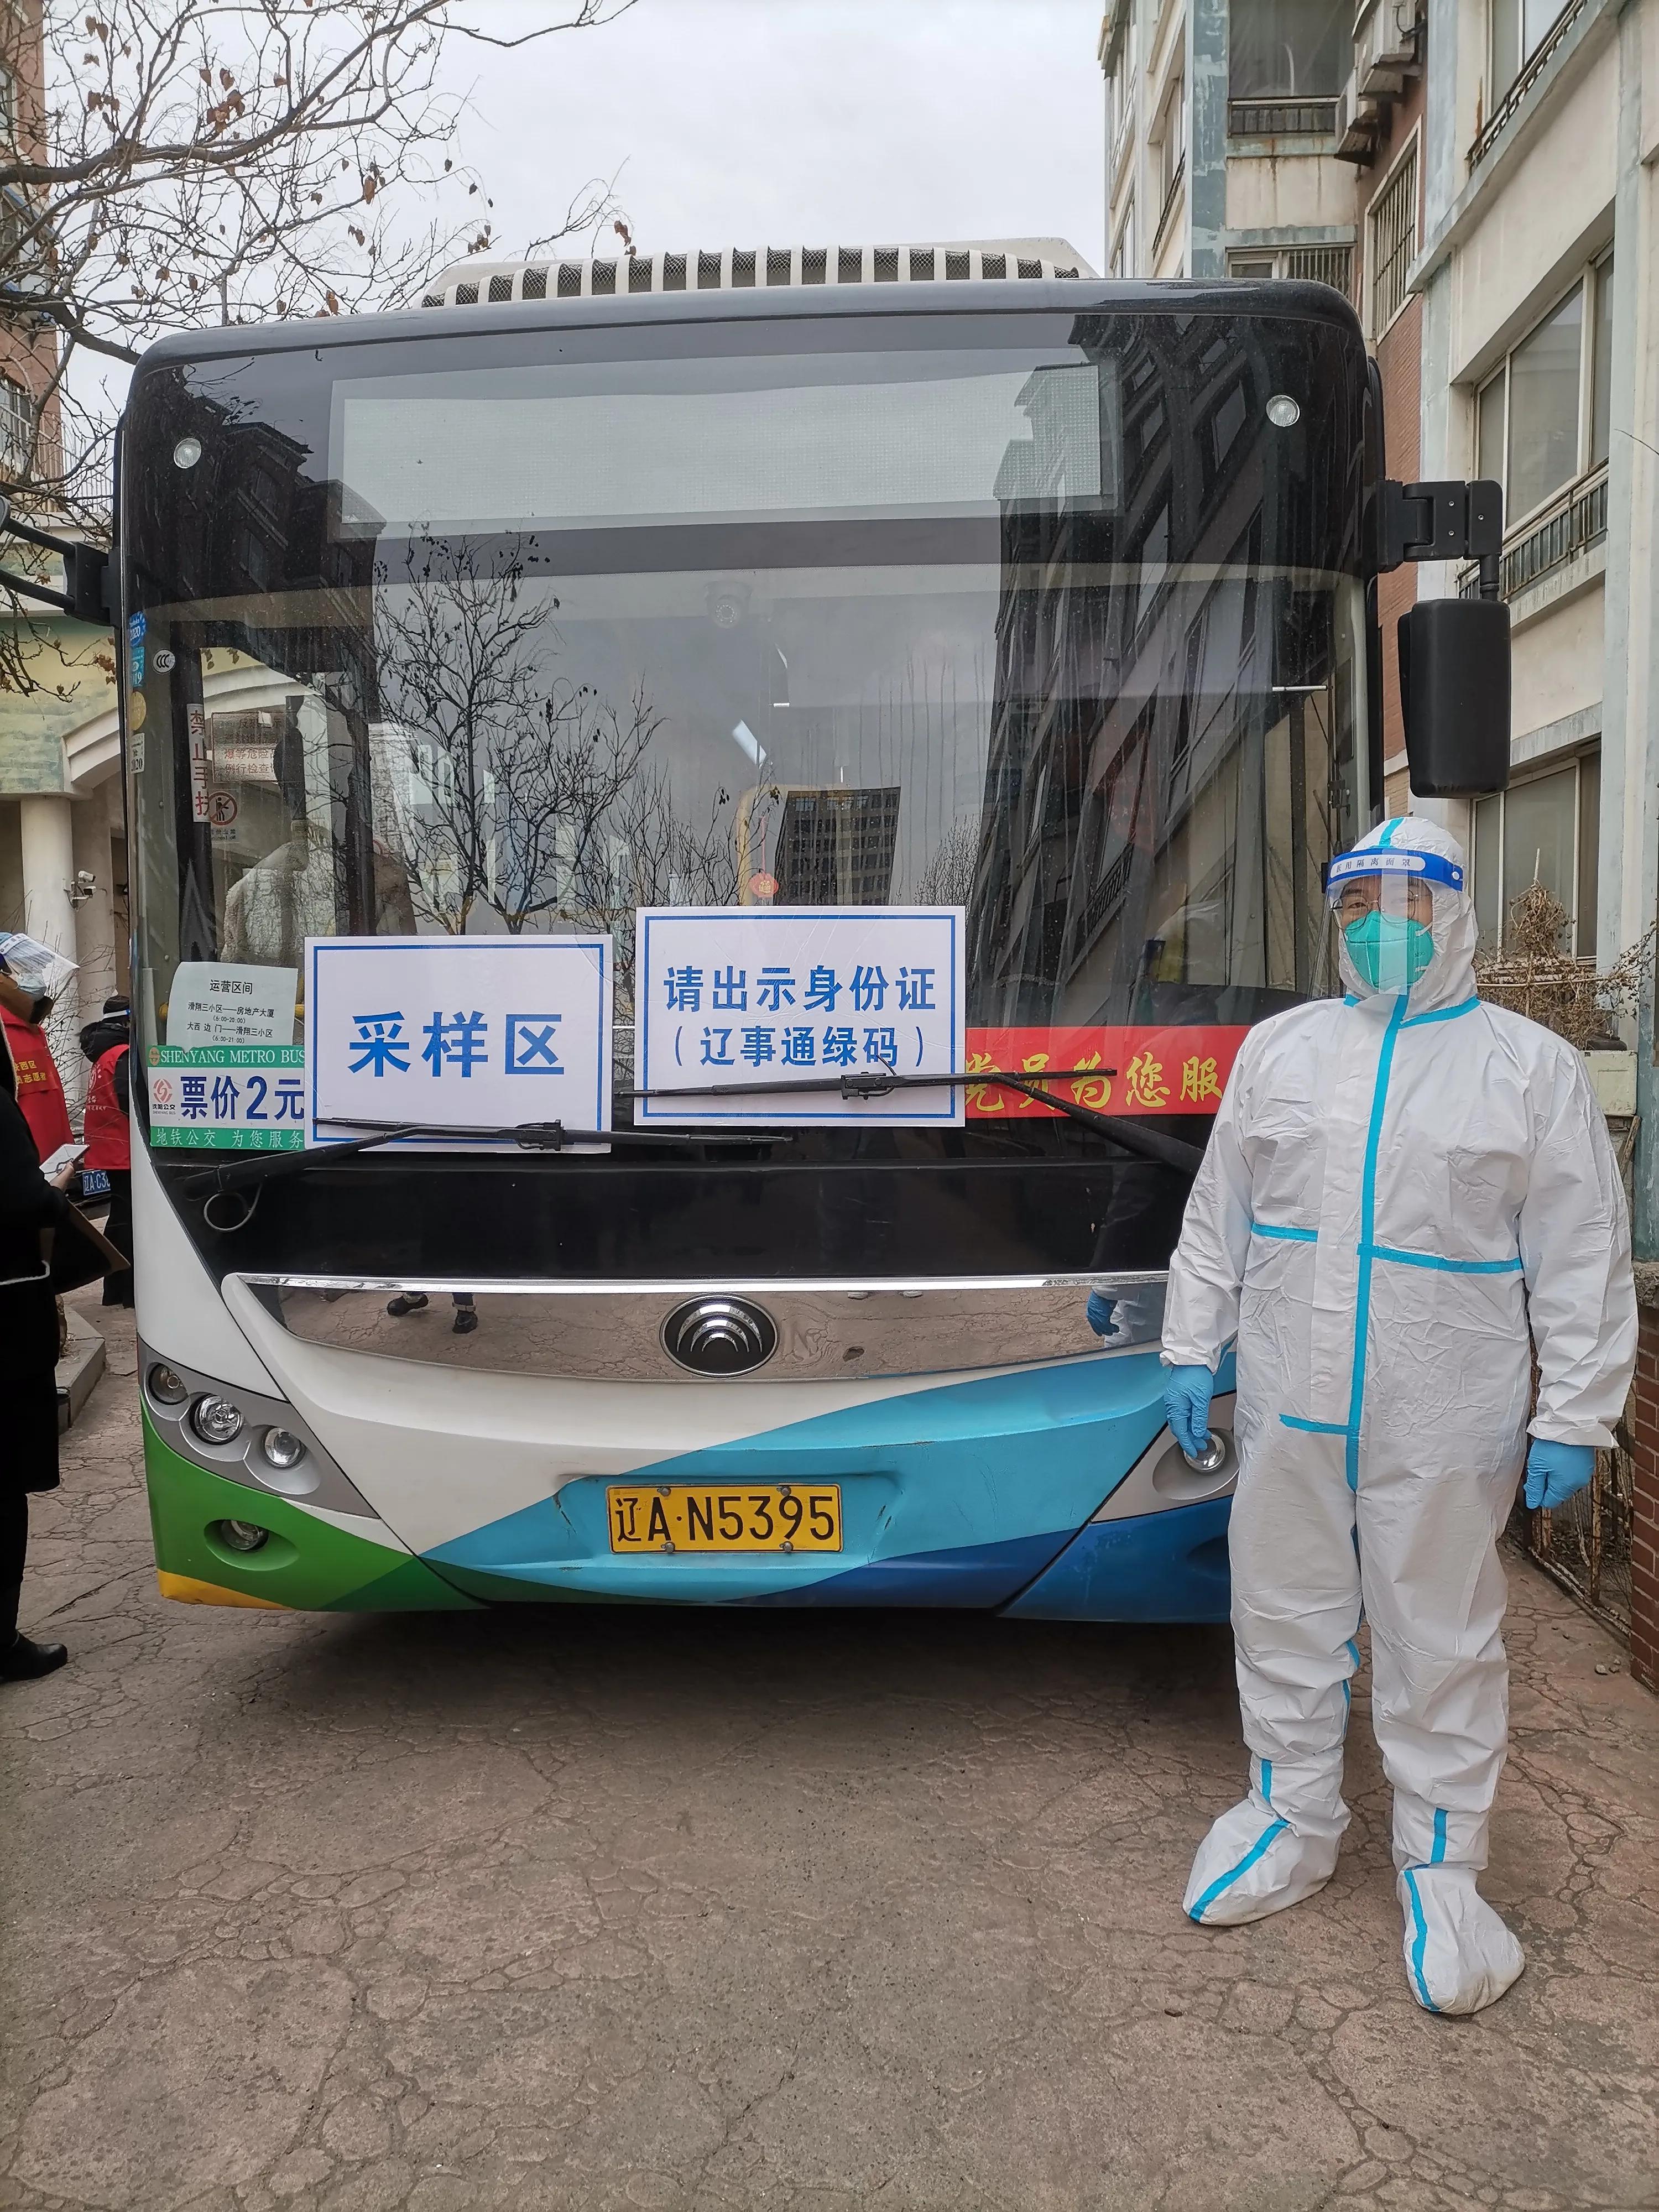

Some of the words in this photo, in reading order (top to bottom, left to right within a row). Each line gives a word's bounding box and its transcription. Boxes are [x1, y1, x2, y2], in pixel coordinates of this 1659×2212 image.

[225, 764, 274, 774] 例行检查
[210, 979, 253, 994] 运营区间
[664, 965, 936, 1012] 请出示身份证
[161, 1050, 225, 1064] SHENYANG
[230, 1050, 275, 1063] METRO
[281, 1050, 304, 1063] BUS
[348, 1011, 565, 1077] 采样区
[180, 1076, 304, 1120] 票价2元
[156, 1129, 216, 1147] 地铁公交
[231, 1130, 304, 1150] 为您服务
[615, 1495, 834, 1541] 辽A·N5395
